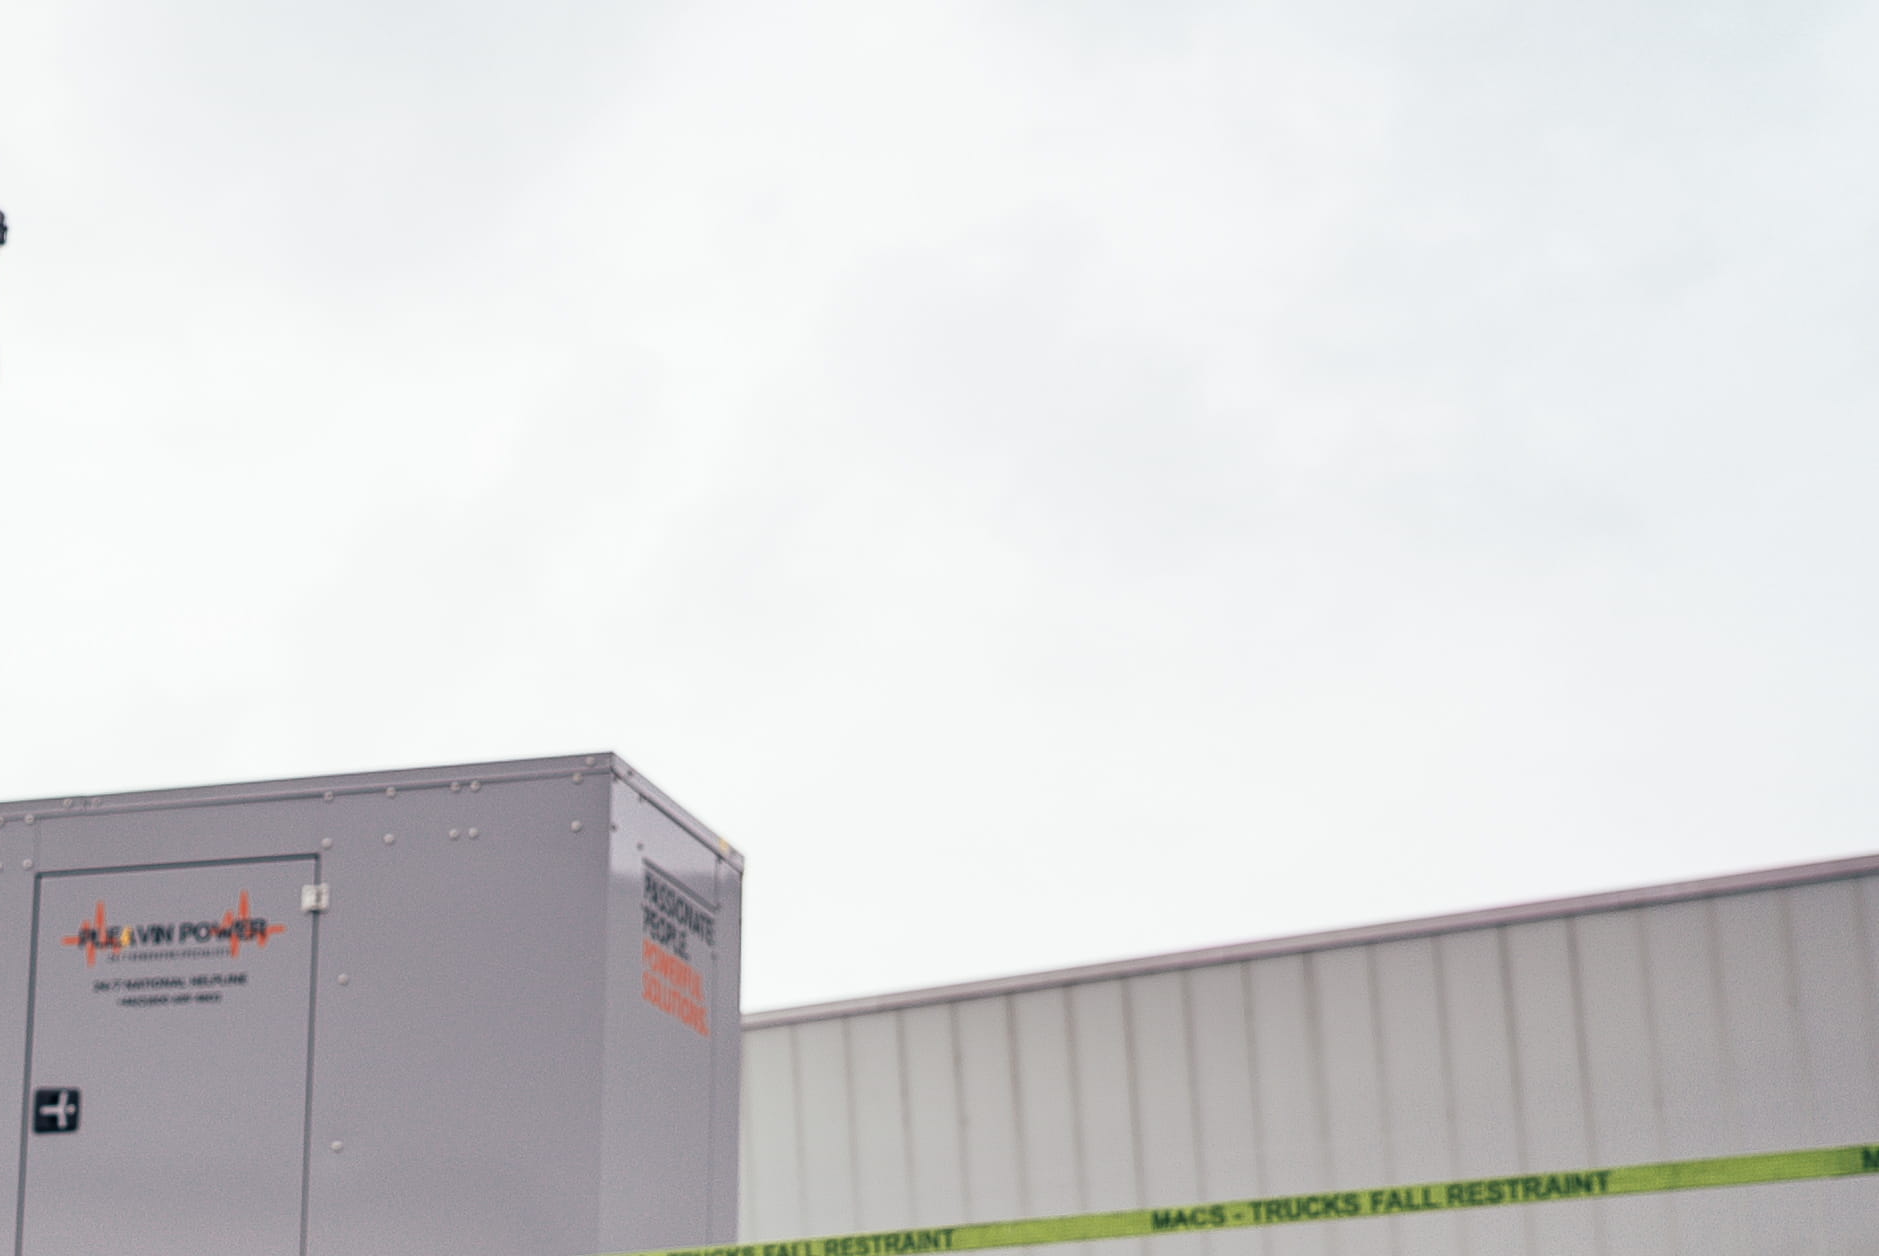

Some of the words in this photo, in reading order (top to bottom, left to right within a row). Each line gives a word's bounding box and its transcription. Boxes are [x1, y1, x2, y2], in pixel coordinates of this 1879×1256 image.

[179, 917, 268, 944] POWER
[1151, 1204, 1225, 1231] MACS
[1250, 1192, 1360, 1224] TRUCKS
[1370, 1186, 1437, 1213] FALL
[1447, 1169, 1611, 1206] RESTRAINT
